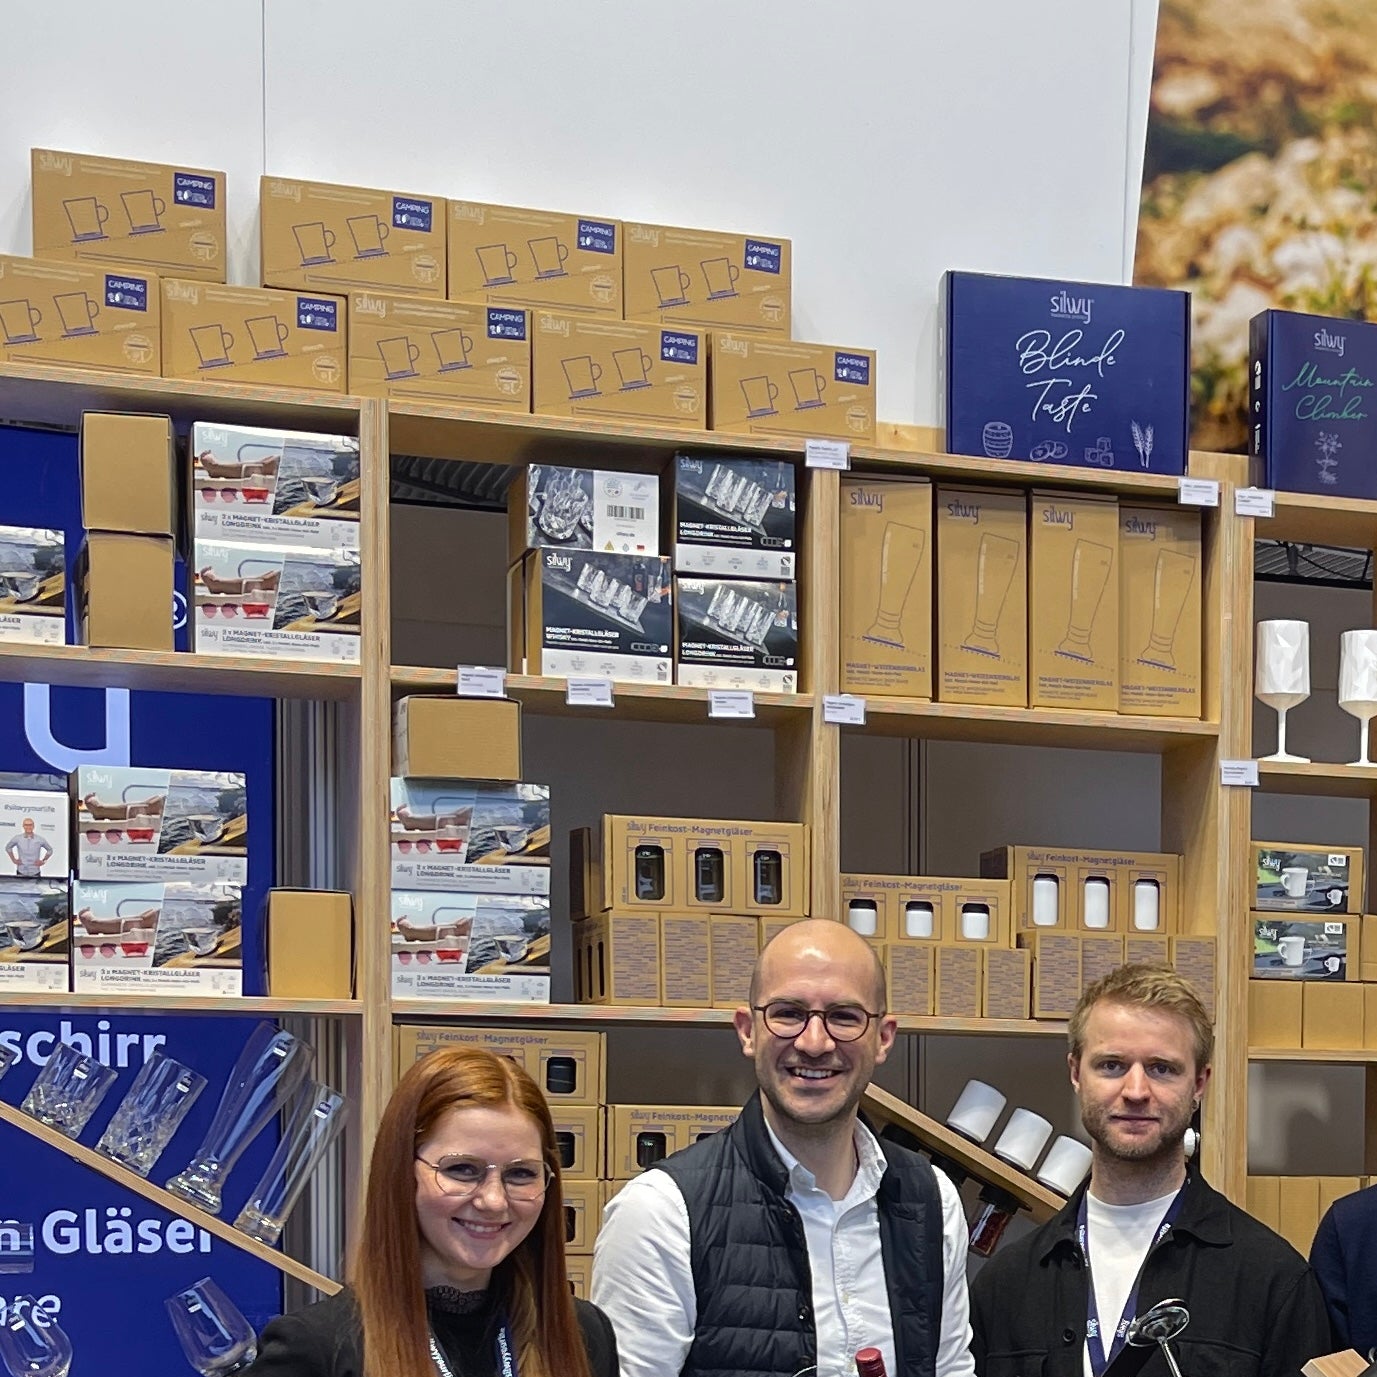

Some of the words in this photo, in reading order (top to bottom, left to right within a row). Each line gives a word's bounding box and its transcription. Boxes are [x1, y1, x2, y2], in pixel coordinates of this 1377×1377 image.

[177, 177, 213, 190] CAMPING
[395, 201, 430, 215] CAMPING
[580, 223, 613, 237] CAMPING
[747, 244, 780, 257] CAMPING
[108, 279, 145, 293] CAMPING
[300, 301, 335, 314] CAMPING
[356, 294, 386, 317] silwy
[1050, 290, 1094, 324] silwy
[489, 312, 523, 324] CAMPING
[663, 336, 696, 349] CAMPING
[1313, 328, 1346, 357] silwy
[1015, 328, 1125, 378] Blinde
[837, 356, 868, 371] CAMPING
[1281, 361, 1374, 391] Mountain
[1026, 378, 1098, 434] Taste
[851, 489, 885, 514] silwy
[947, 502, 981, 526] silwy
[1042, 506, 1076, 530] silwy
[1125, 517, 1159, 542] silwy
[547, 553, 573, 572] silwy
[648, 823, 754, 837] Feinkost-Magnetgläser
[1045, 854, 1136, 867] Feinkost-Magnetgläser
[863, 880, 963, 892] Feinkost-Magnetgläser
[438, 1032, 549, 1045] Feinkost-Magnetgläser
[652, 1112, 739, 1123] Feinkost-Magnetgl
